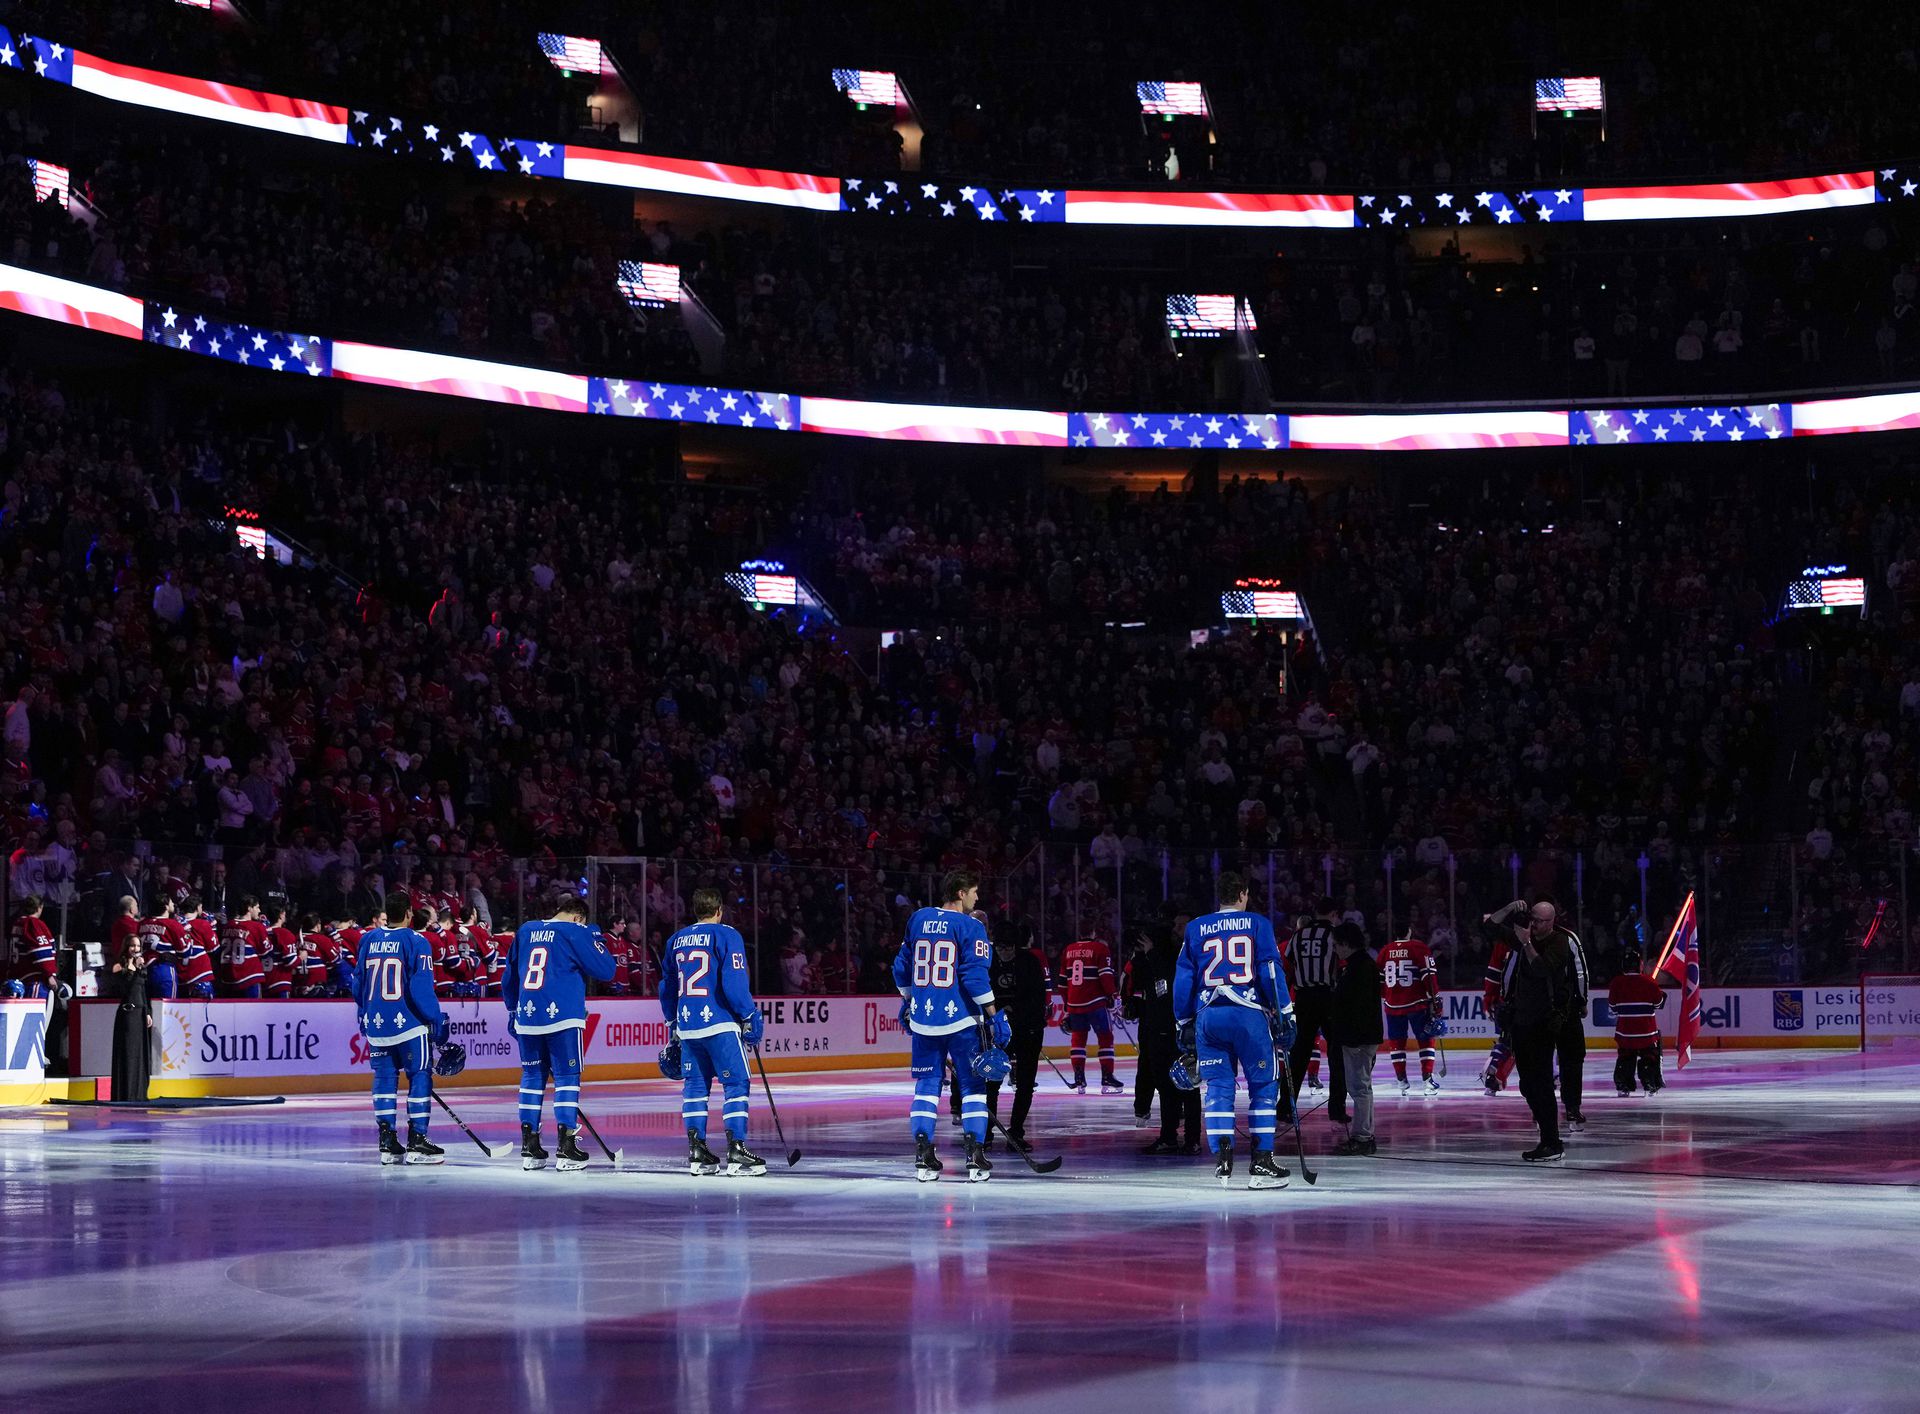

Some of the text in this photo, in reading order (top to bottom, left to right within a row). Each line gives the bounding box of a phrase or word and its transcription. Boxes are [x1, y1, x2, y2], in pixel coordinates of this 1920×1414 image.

[922, 921, 949, 935] NECAS
[530, 930, 555, 944] MAKAR
[673, 934, 711, 950] LEHKONEN
[369, 941, 401, 954] MALINSKI
[974, 939, 990, 960] 88
[1301, 940, 1322, 958] 36
[1388, 949, 1409, 959] TEXIER
[420, 954, 434, 971] 70
[522, 946, 549, 990] 8
[912, 938, 958, 989] 88
[1202, 935, 1254, 988] 29
[365, 957, 405, 1002] 70
[1071, 959, 1085, 986] 8
[1384, 960, 1414, 988] 85
[1814, 991, 1844, 1005] Les
[754, 1000, 829, 1024] HE KEG
[449, 1018, 489, 1035] enant
[1775, 1018, 1801, 1029] RBC
[201, 1019, 320, 1063] Sun Life
[470, 1038, 511, 1057] l'année
[803, 1037, 829, 1051] BAR
[1199, 1058, 1223, 1067] CCM
